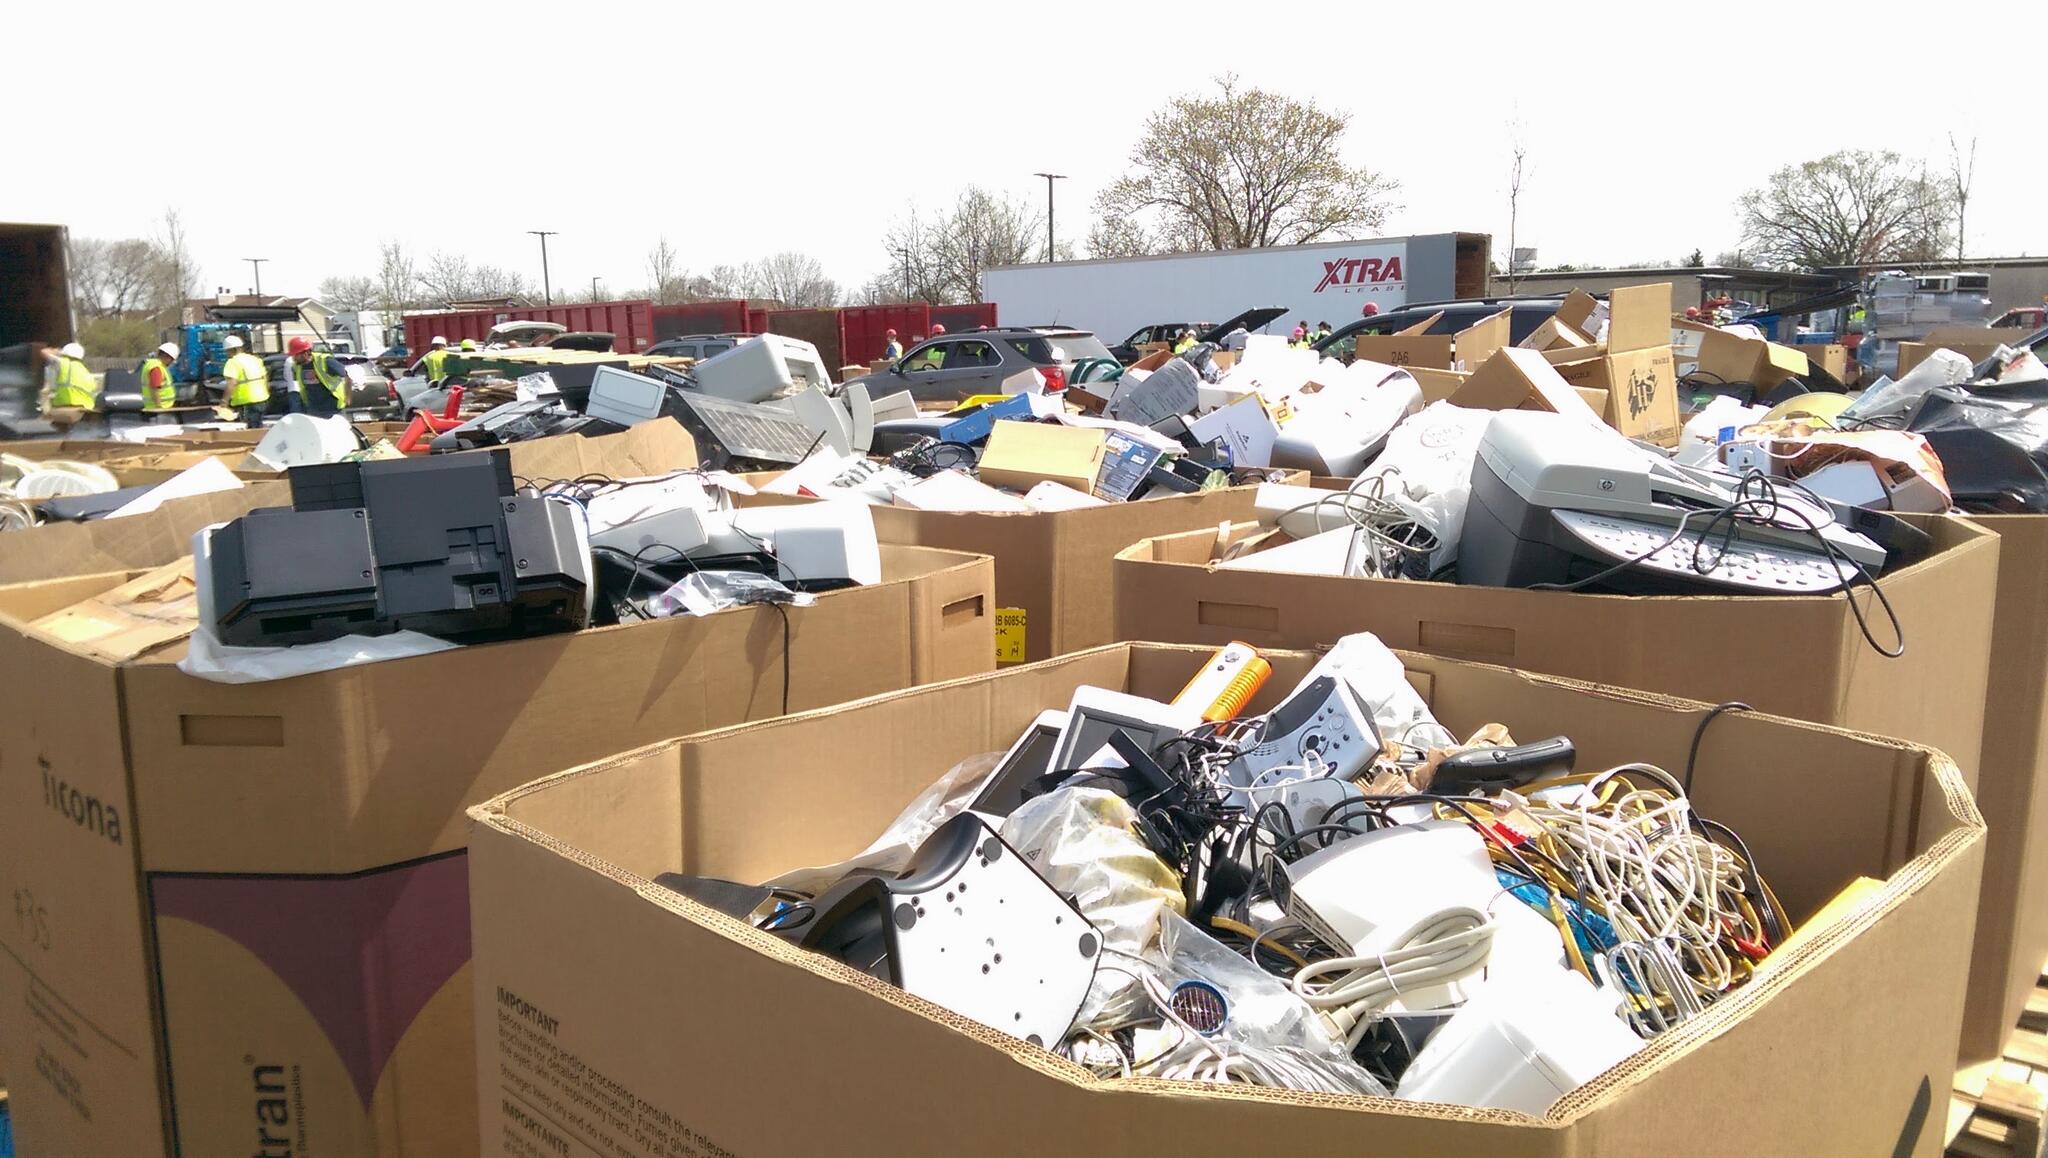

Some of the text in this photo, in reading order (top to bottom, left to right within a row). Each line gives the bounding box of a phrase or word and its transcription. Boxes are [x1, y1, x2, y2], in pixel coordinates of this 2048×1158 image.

[1313, 257, 1403, 293] XTRA
[1391, 351, 1409, 364] 2A6
[38, 754, 122, 846] Ticona
[497, 986, 559, 1038] IMPORTANT
[500, 1042, 512, 1057] the
[551, 1077, 560, 1088] or
[562, 1085, 606, 1122] respiratory
[635, 1129, 650, 1152] Dry
[653, 1145, 664, 1158] all
[523, 1027, 557, 1059] handling
[560, 1048, 585, 1074] and/or
[588, 1067, 634, 1108] processing
[637, 1098, 671, 1127] consult
[673, 1119, 690, 1140] the
[534, 1048, 545, 1063] for
[546, 1059, 580, 1086] detailed
[638, 1115, 668, 1144] Fumes
[670, 1139, 697, 1158] given
[553, 1101, 566, 1120] dry
[568, 1112, 583, 1129] and
[586, 1123, 597, 1138] do
[599, 1133, 615, 1150] not
